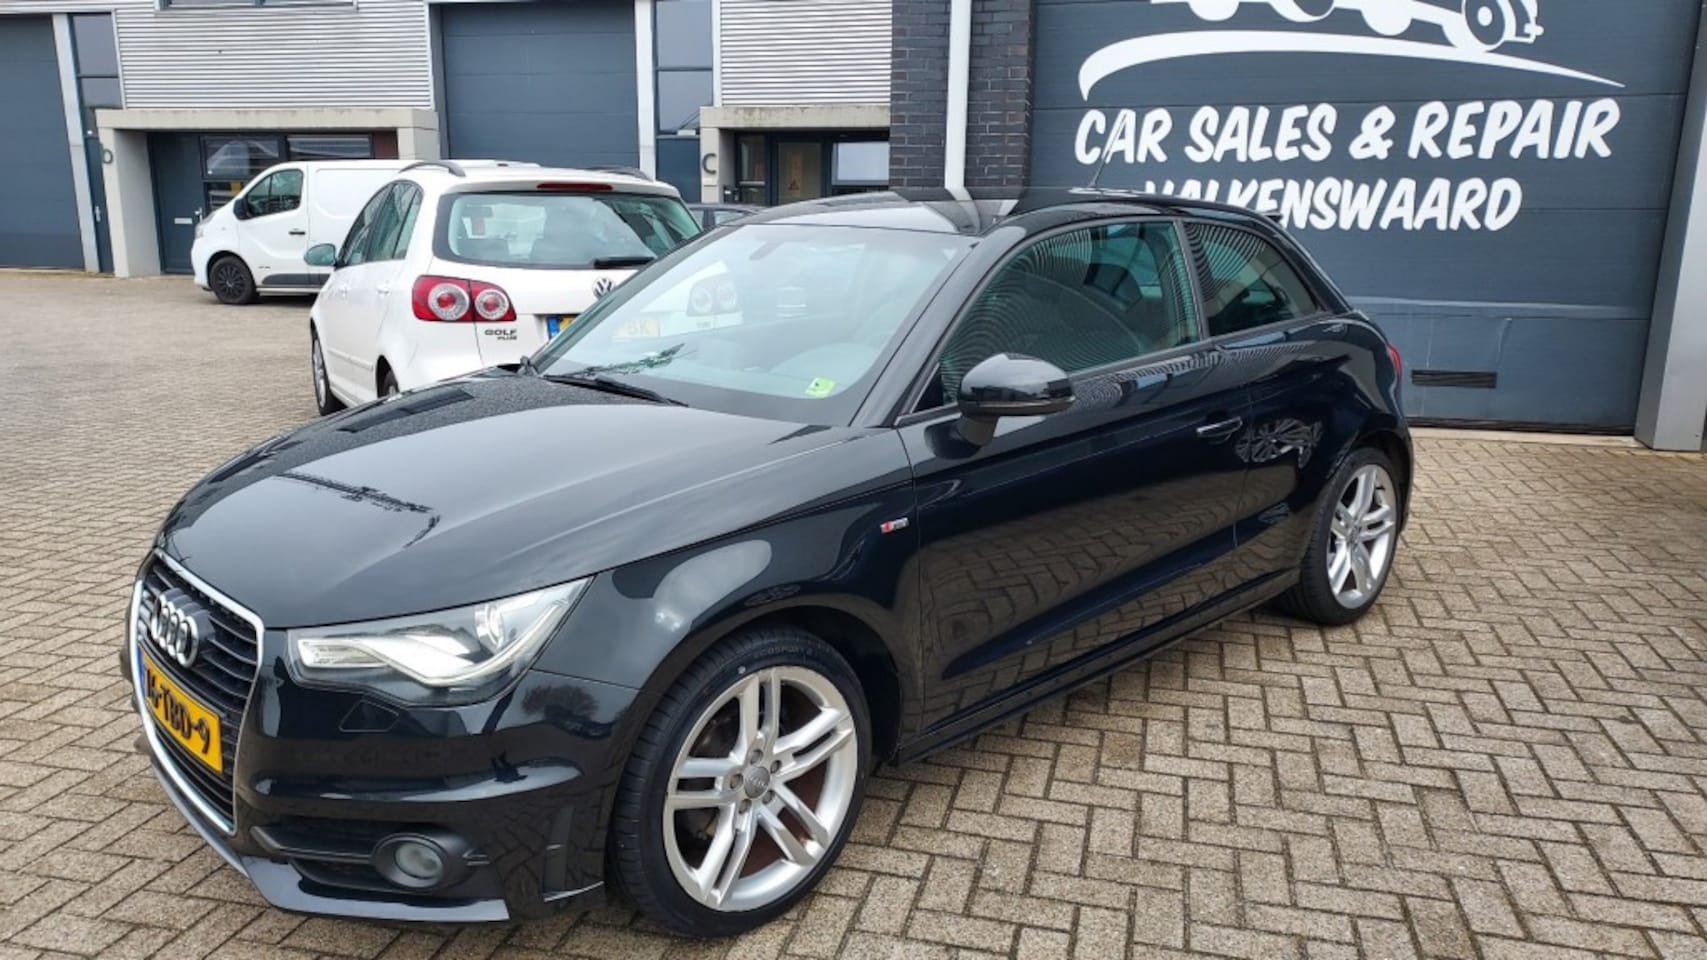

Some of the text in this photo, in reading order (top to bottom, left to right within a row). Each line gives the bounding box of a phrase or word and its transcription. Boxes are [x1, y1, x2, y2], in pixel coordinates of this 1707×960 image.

[1075, 98, 1620, 164] CAR SALES & REPAIR
[702, 152, 717, 175] C
[1145, 177, 1522, 231] KENSWAARD
[484, 328, 518, 336] GOLF
